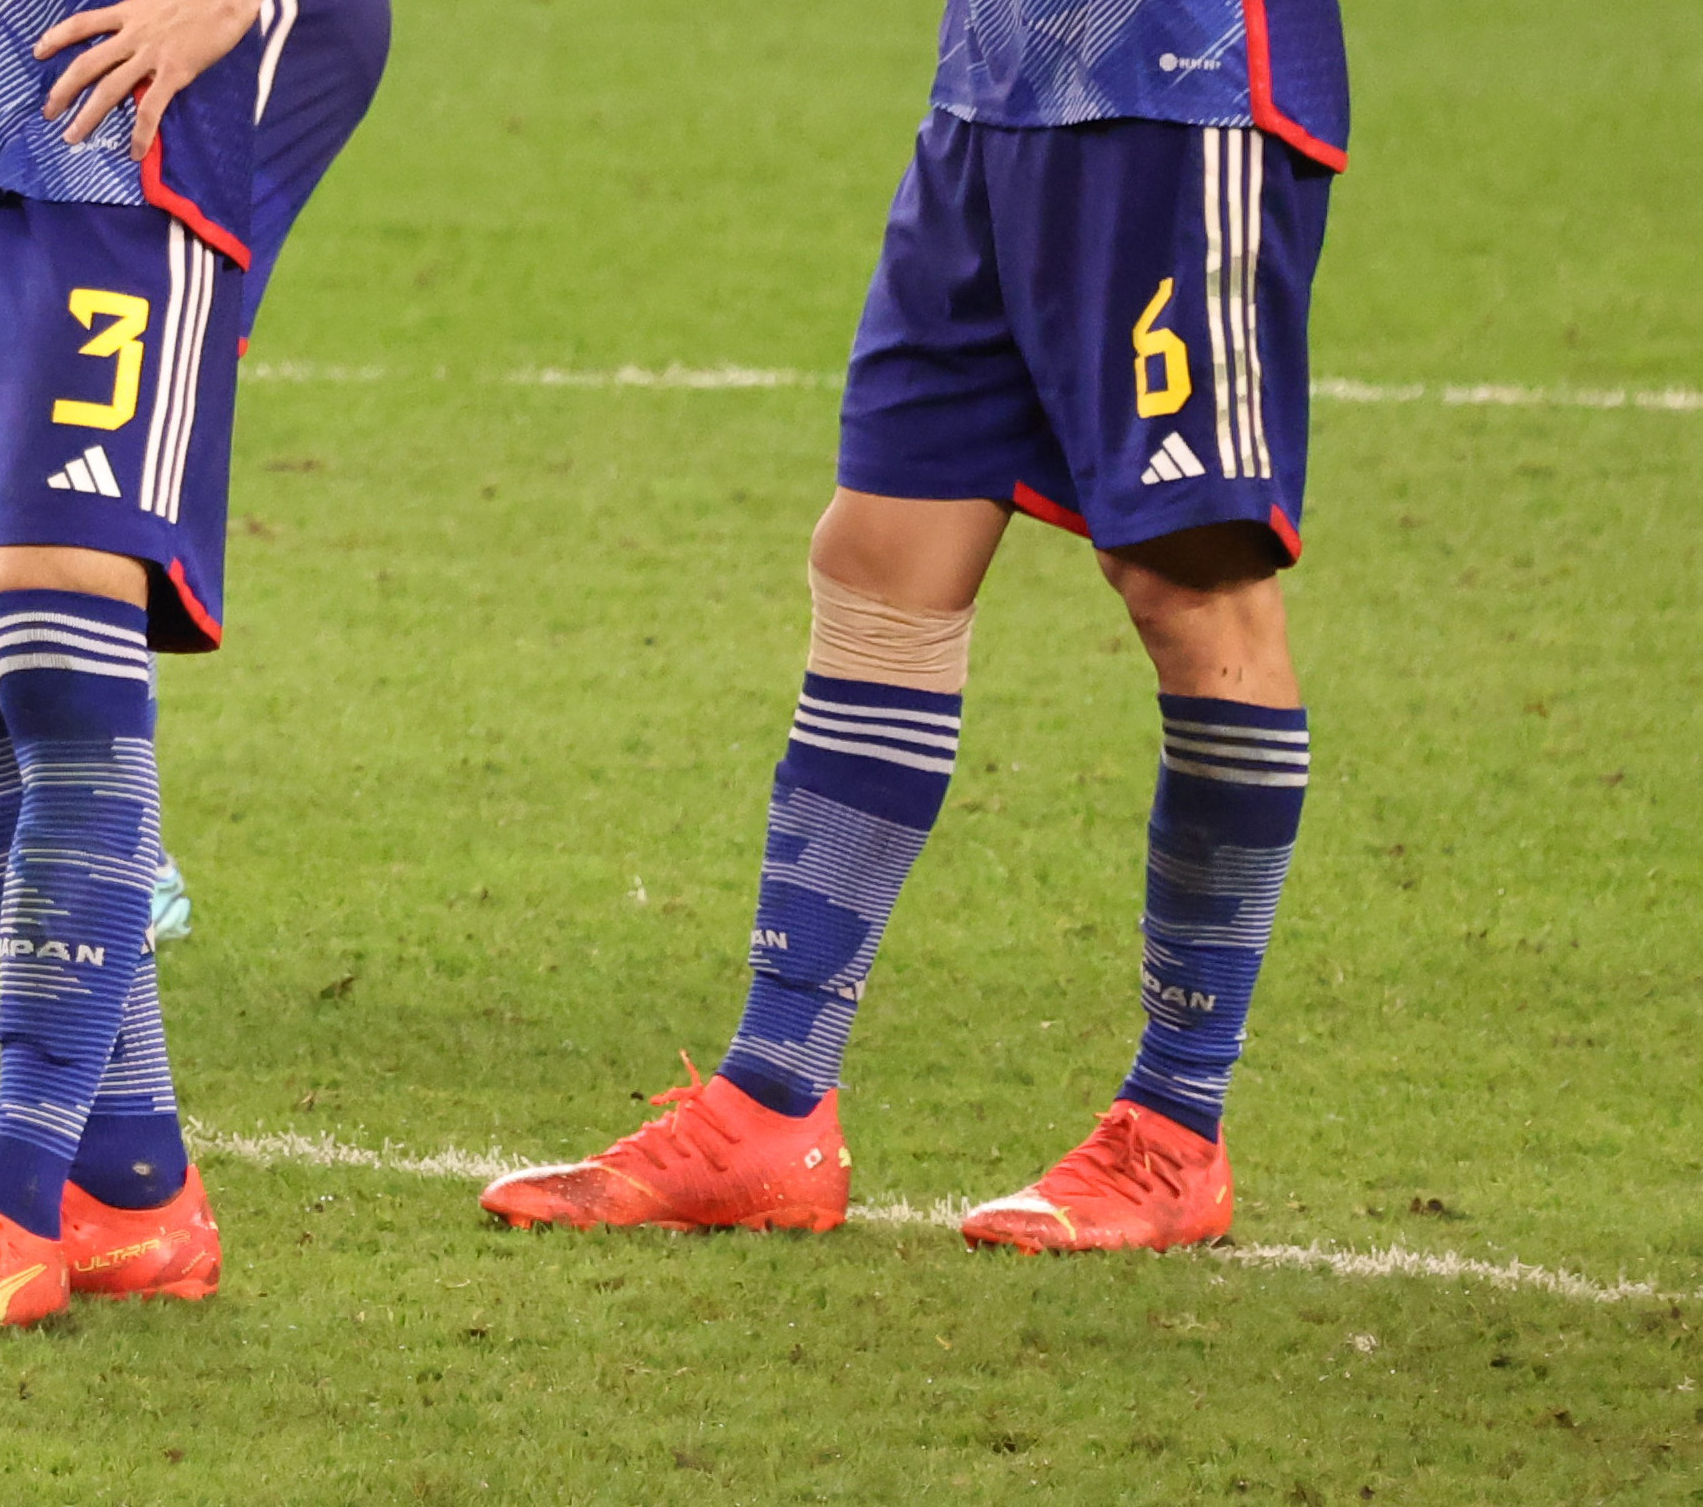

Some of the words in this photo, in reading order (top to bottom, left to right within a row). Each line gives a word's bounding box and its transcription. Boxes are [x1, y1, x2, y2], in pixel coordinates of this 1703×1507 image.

[52, 289, 149, 430] 3
[1133, 277, 1192, 418] 6
[1139, 962, 1216, 1011] PAN
[74, 1239, 161, 1272] ULTRA
